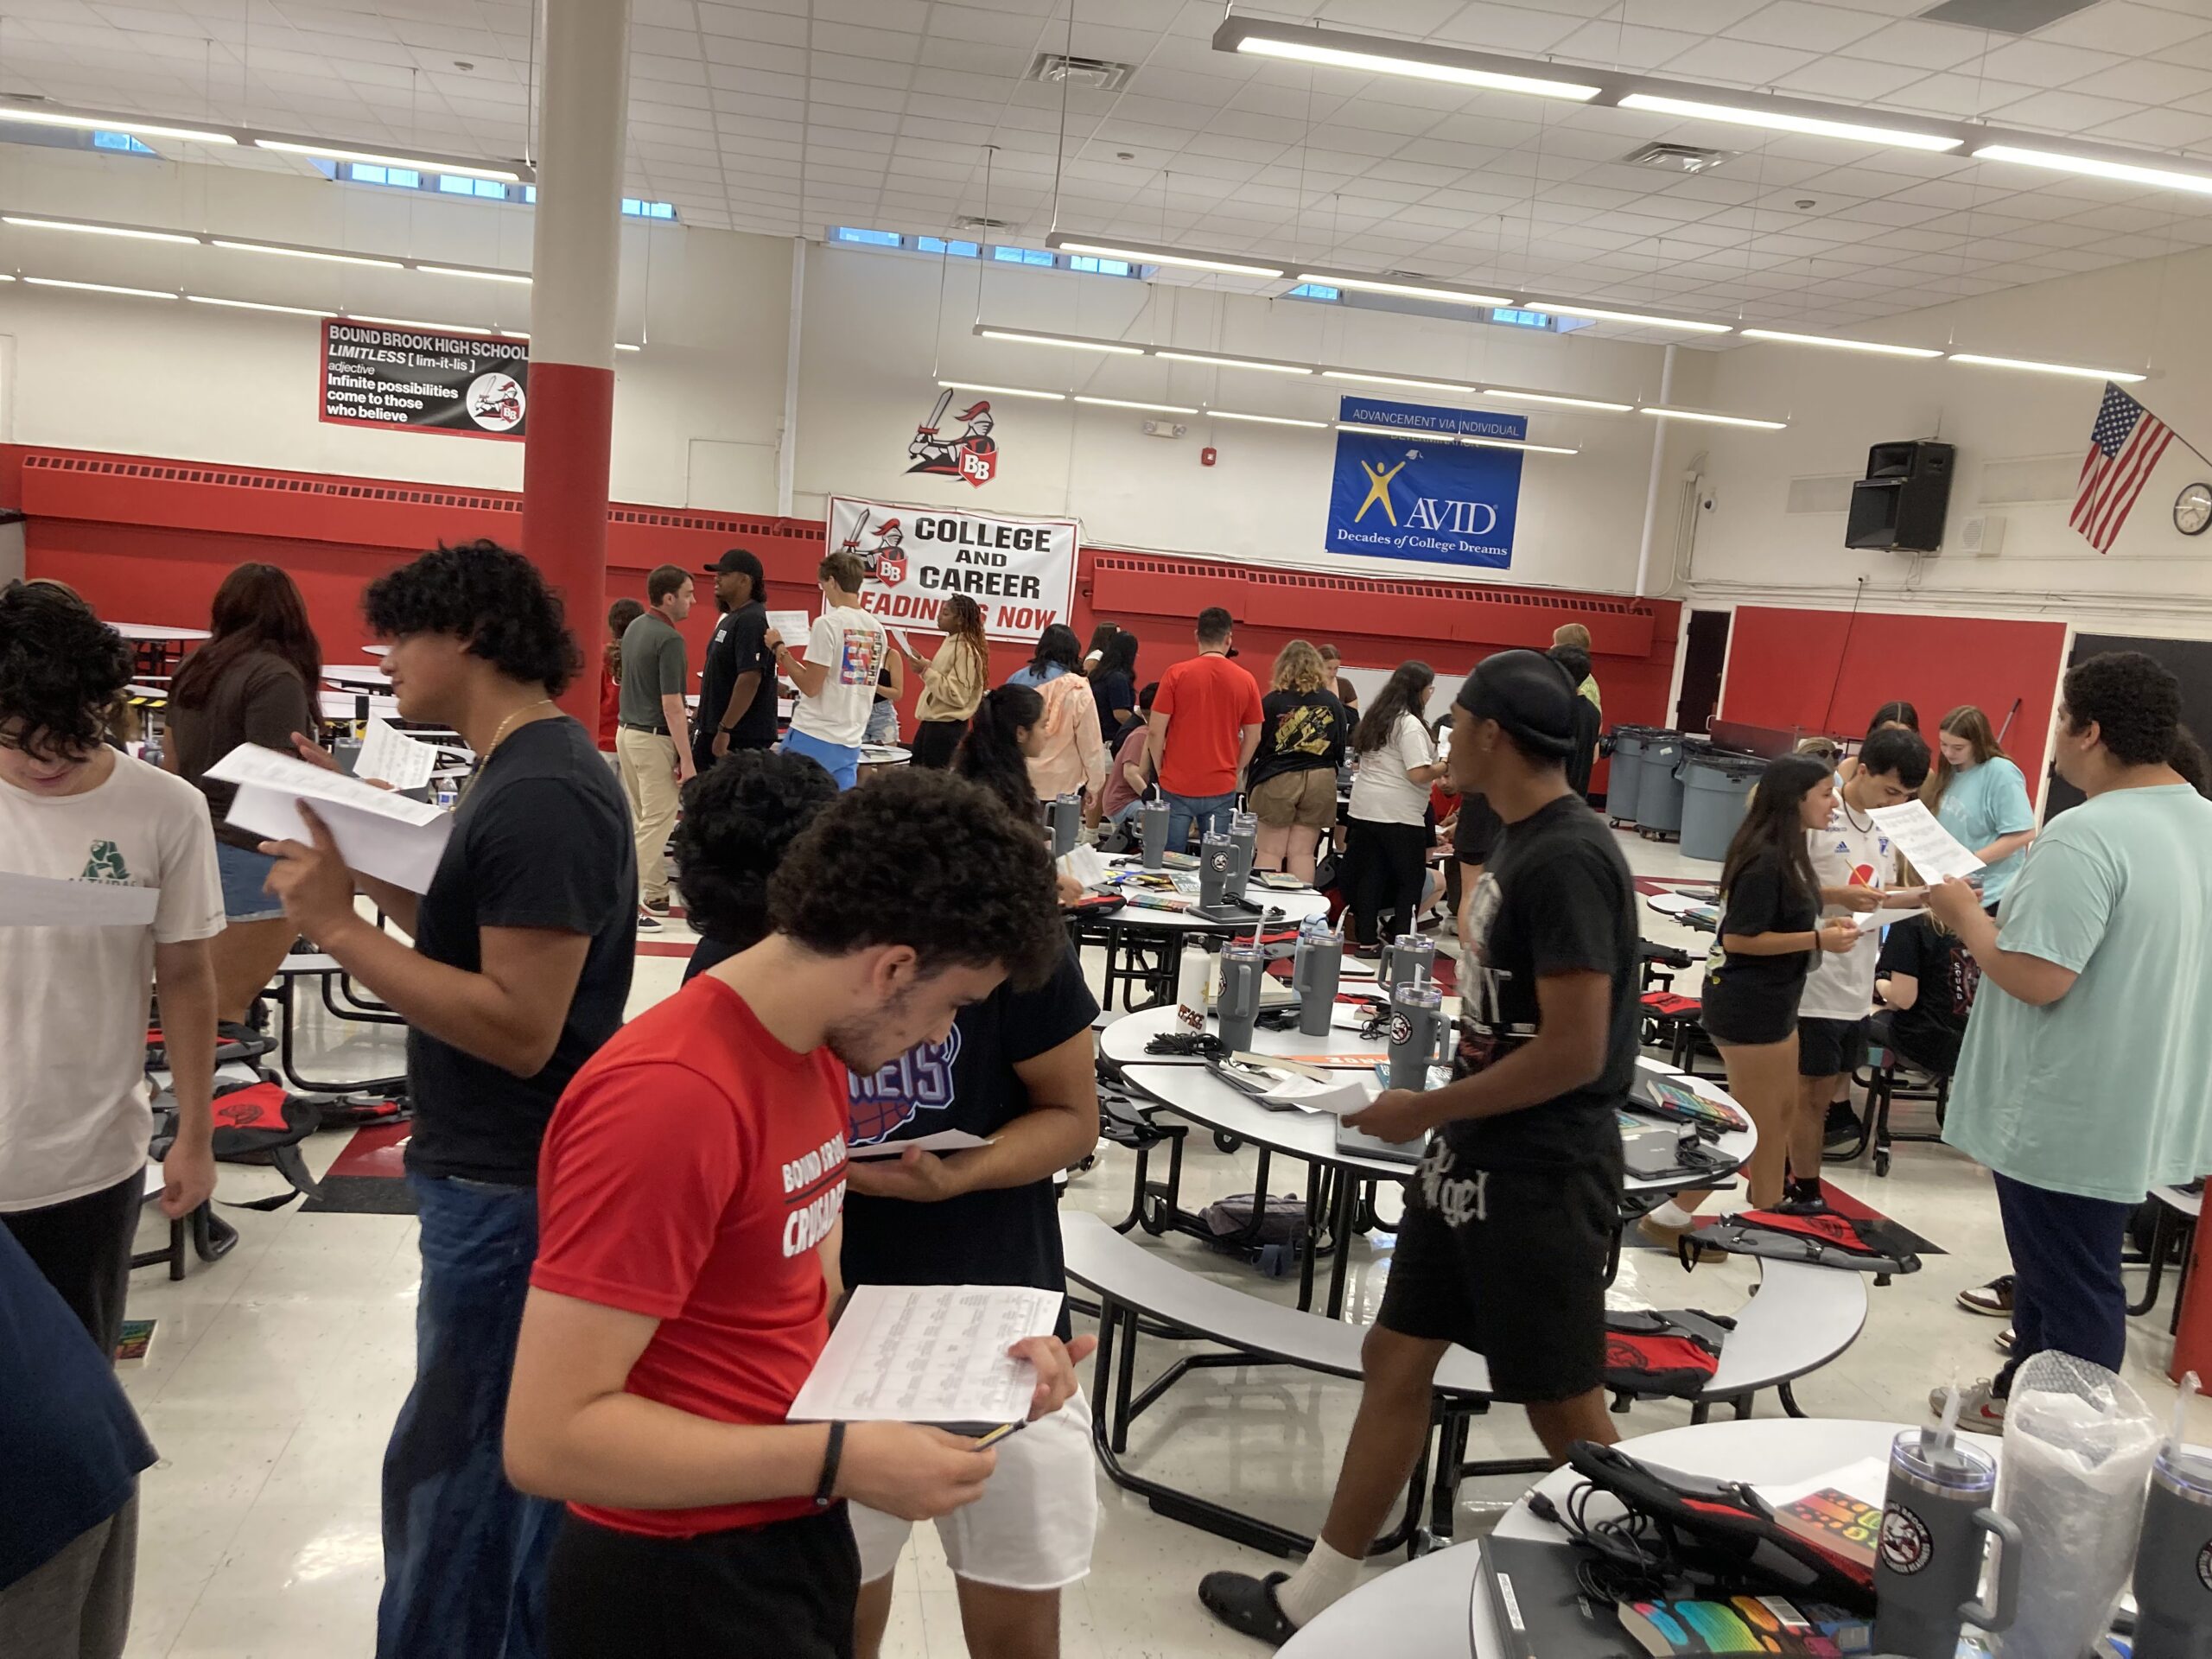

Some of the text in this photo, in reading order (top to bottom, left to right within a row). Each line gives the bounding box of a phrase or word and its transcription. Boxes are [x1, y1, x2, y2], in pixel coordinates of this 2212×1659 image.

[329, 325, 529, 360] BOUND BROOK HIGH SCHOOL
[329, 344, 406, 364] LIMITLESS
[327, 359, 375, 375] adjective
[327, 373, 459, 399] Infinite possibilities
[327, 391, 423, 410] come to those
[327, 404, 408, 423] who believe
[503, 407, 517, 420] BB
[1353, 409, 1520, 436] ADVANCEMENT VIA INDIVIDUAL
[963, 454, 990, 480] BB
[1403, 497, 1497, 535] AVID
[915, 518, 1052, 553] COLLEGE
[1338, 529, 1508, 556] Decades of College Dreams
[880, 562, 901, 582] BB
[955, 550, 1007, 568] AND
[918, 566, 1040, 600] CAREER
[997, 605, 1057, 631] NOW
